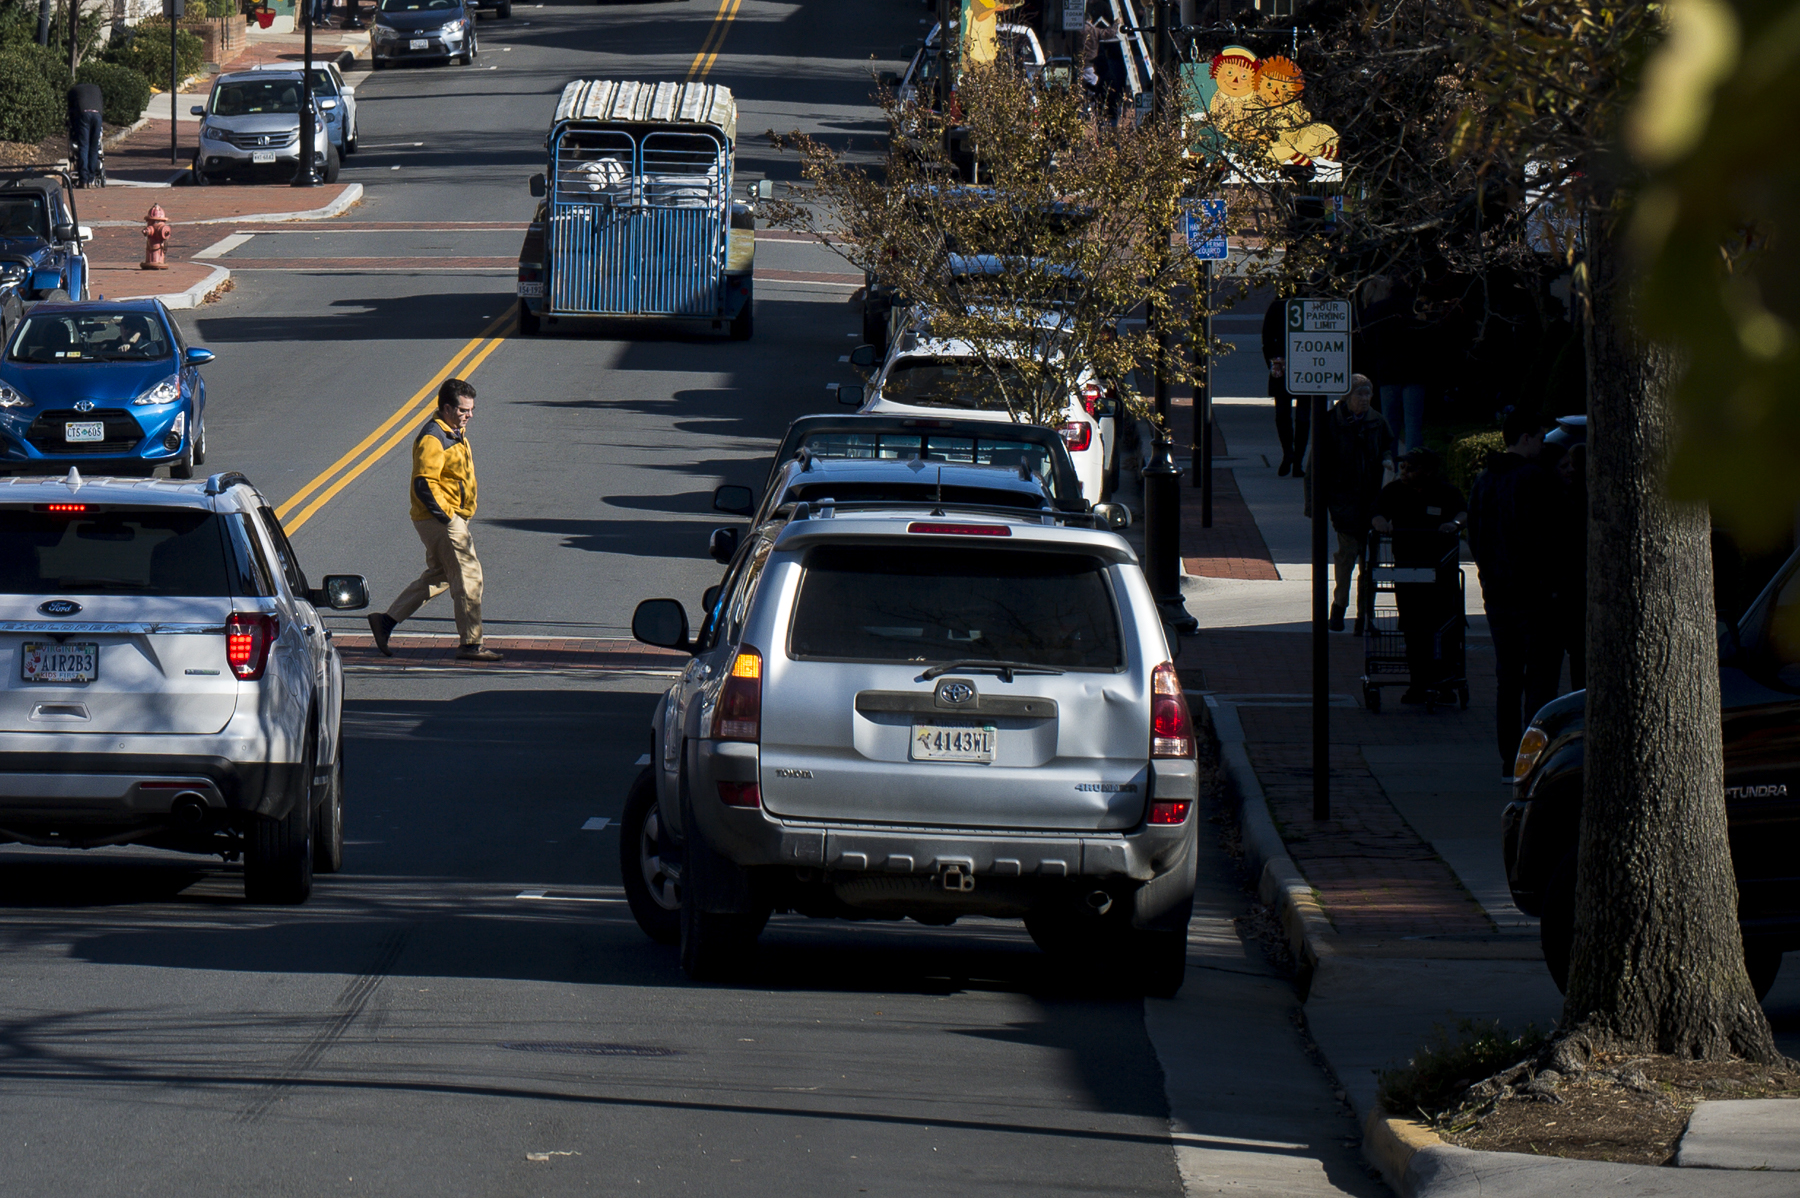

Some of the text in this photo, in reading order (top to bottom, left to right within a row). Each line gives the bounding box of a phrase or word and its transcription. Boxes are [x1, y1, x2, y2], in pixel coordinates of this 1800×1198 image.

[1290, 303, 1339, 328] 3 HOUR
[1306, 312, 1346, 321] PARKING
[1314, 321, 1337, 330] LIMIT
[1294, 340, 1344, 353] 7:00AM
[1313, 357, 1326, 367] TO
[1294, 371, 1344, 384] 7:00PM
[48, 602, 73, 613] Ford
[1, 623, 120, 632] EXPLORER
[41, 645, 80, 653] VIRGINIA
[41, 654, 93, 673] A1R2B3
[933, 730, 992, 753] 4143WL
[775, 768, 814, 779] TOYOTA
[1730, 783, 1788, 799] TUNDRA
